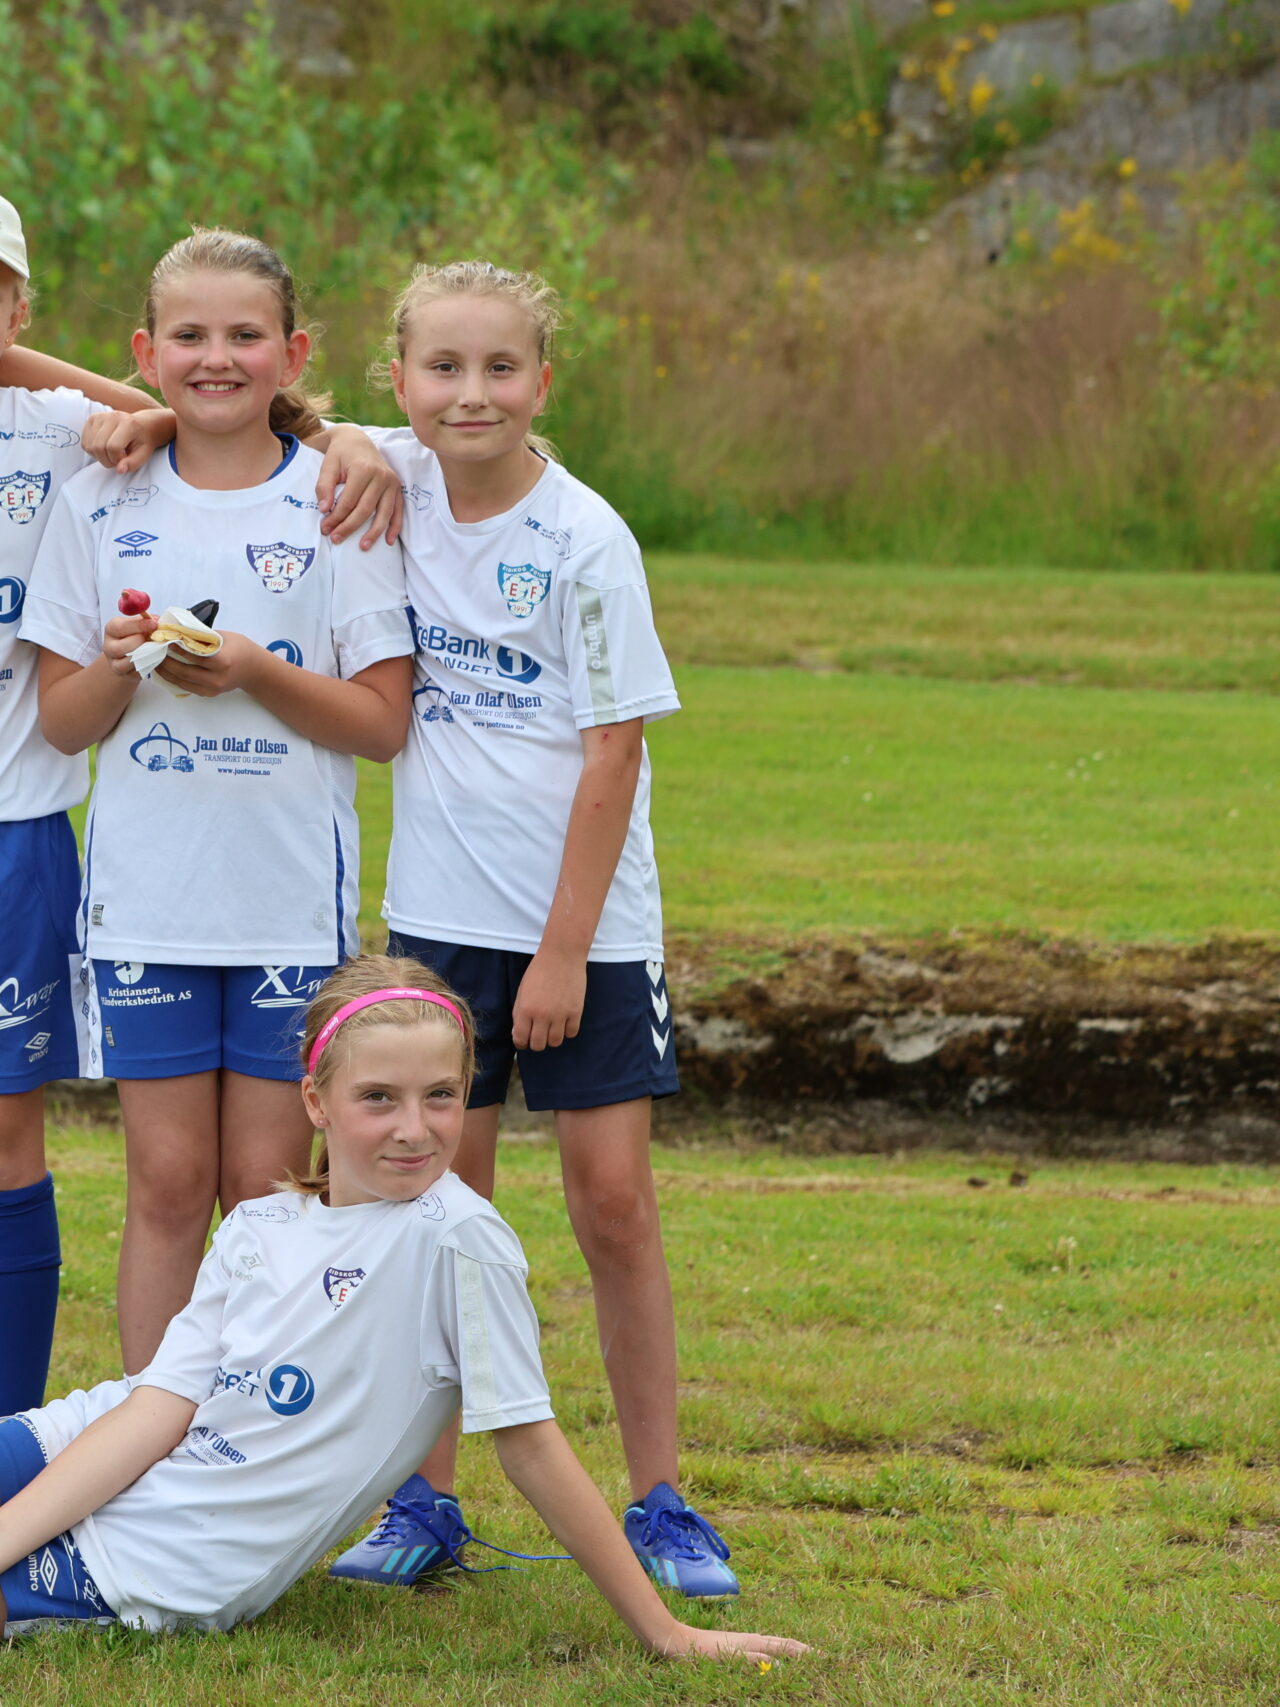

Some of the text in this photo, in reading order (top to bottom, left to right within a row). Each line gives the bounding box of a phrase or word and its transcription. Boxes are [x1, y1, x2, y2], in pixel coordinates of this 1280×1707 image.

[7, 490, 34, 505] E F
[118, 547, 152, 559] umbro
[264, 560, 295, 575] E F
[509, 583, 537, 599] E F
[417, 625, 490, 661] reBank
[585, 614, 602, 670] umbro
[475, 692, 504, 708] Olaf
[193, 736, 288, 754] Jan Olaf Olsen
[108, 987, 161, 997] Kristiansen
[178, 990, 192, 1001] AS
[328, 1268, 358, 1278] EIDSKOG
[338, 1287, 348, 1302] E
[28, 1553, 40, 1592] umbro
